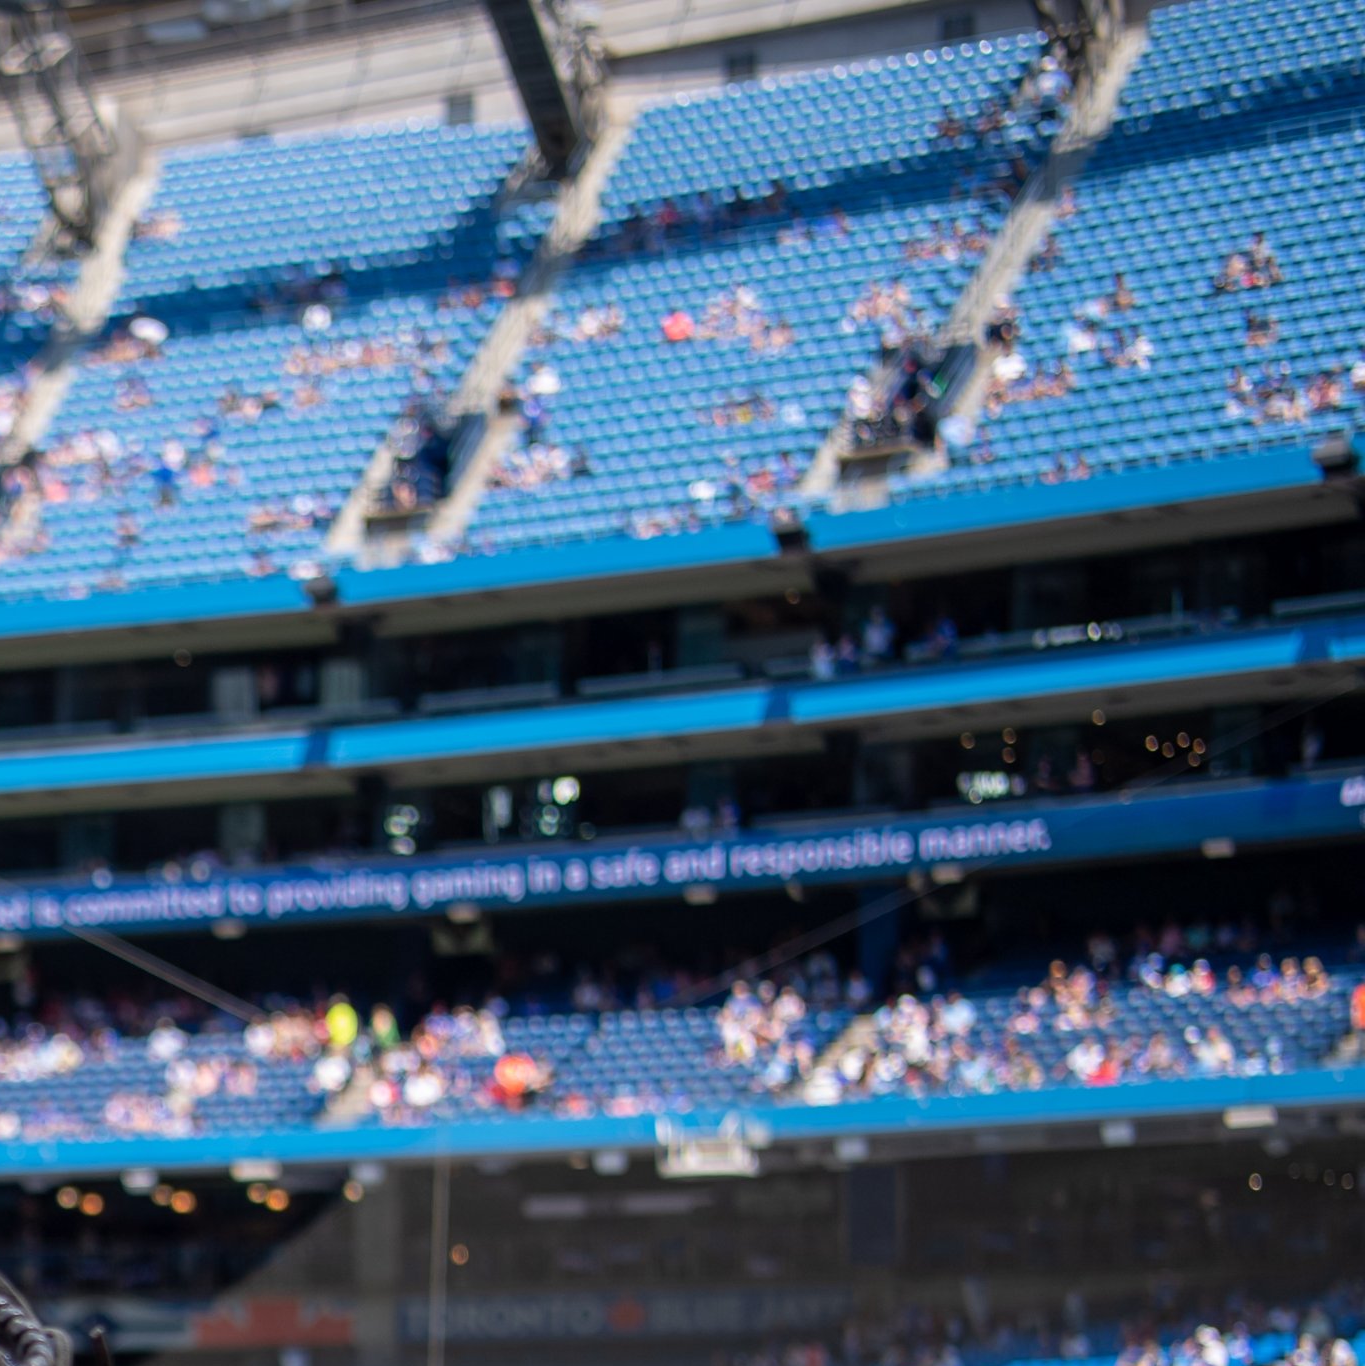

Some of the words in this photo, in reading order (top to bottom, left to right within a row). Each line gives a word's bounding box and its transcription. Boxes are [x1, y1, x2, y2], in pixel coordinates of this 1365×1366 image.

[32, 889, 63, 928] is
[64, 881, 225, 926] committed
[226, 875, 265, 917] to
[267, 868, 409, 919] providing
[410, 859, 526, 909] gaming
[527, 854, 562, 894] in
[564, 857, 588, 892] a
[590, 847, 661, 890] safe
[664, 840, 727, 883] and
[730, 826, 916, 879] responsible
[918, 818, 1052, 861] manner.
